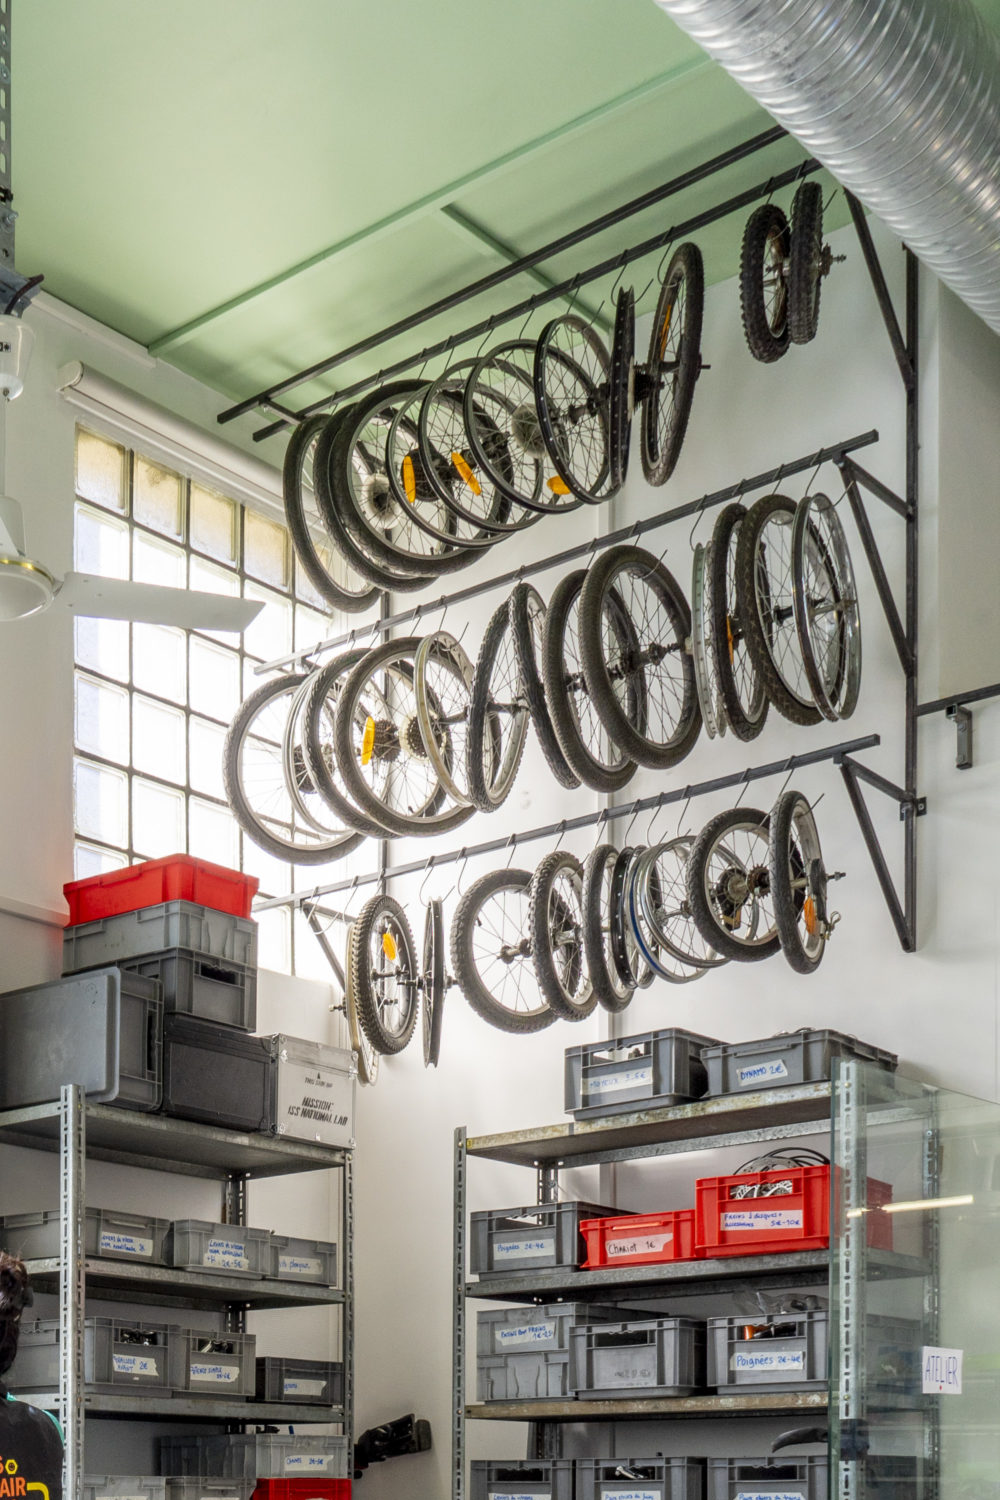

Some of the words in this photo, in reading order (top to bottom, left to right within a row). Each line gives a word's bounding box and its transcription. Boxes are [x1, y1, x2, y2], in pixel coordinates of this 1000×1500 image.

[740, 1068, 767, 1081] DYNAMO
[770, 1064, 785, 1075] 2€
[288, 1105, 301, 1117] ISS
[300, 1107, 333, 1124] NATIONAL
[333, 1114, 349, 1127] LAB
[646, 1241, 656, 1250] 1€
[736, 1353, 773, 1369] Poignées
[924, 1355, 959, 1387] ATELIER
